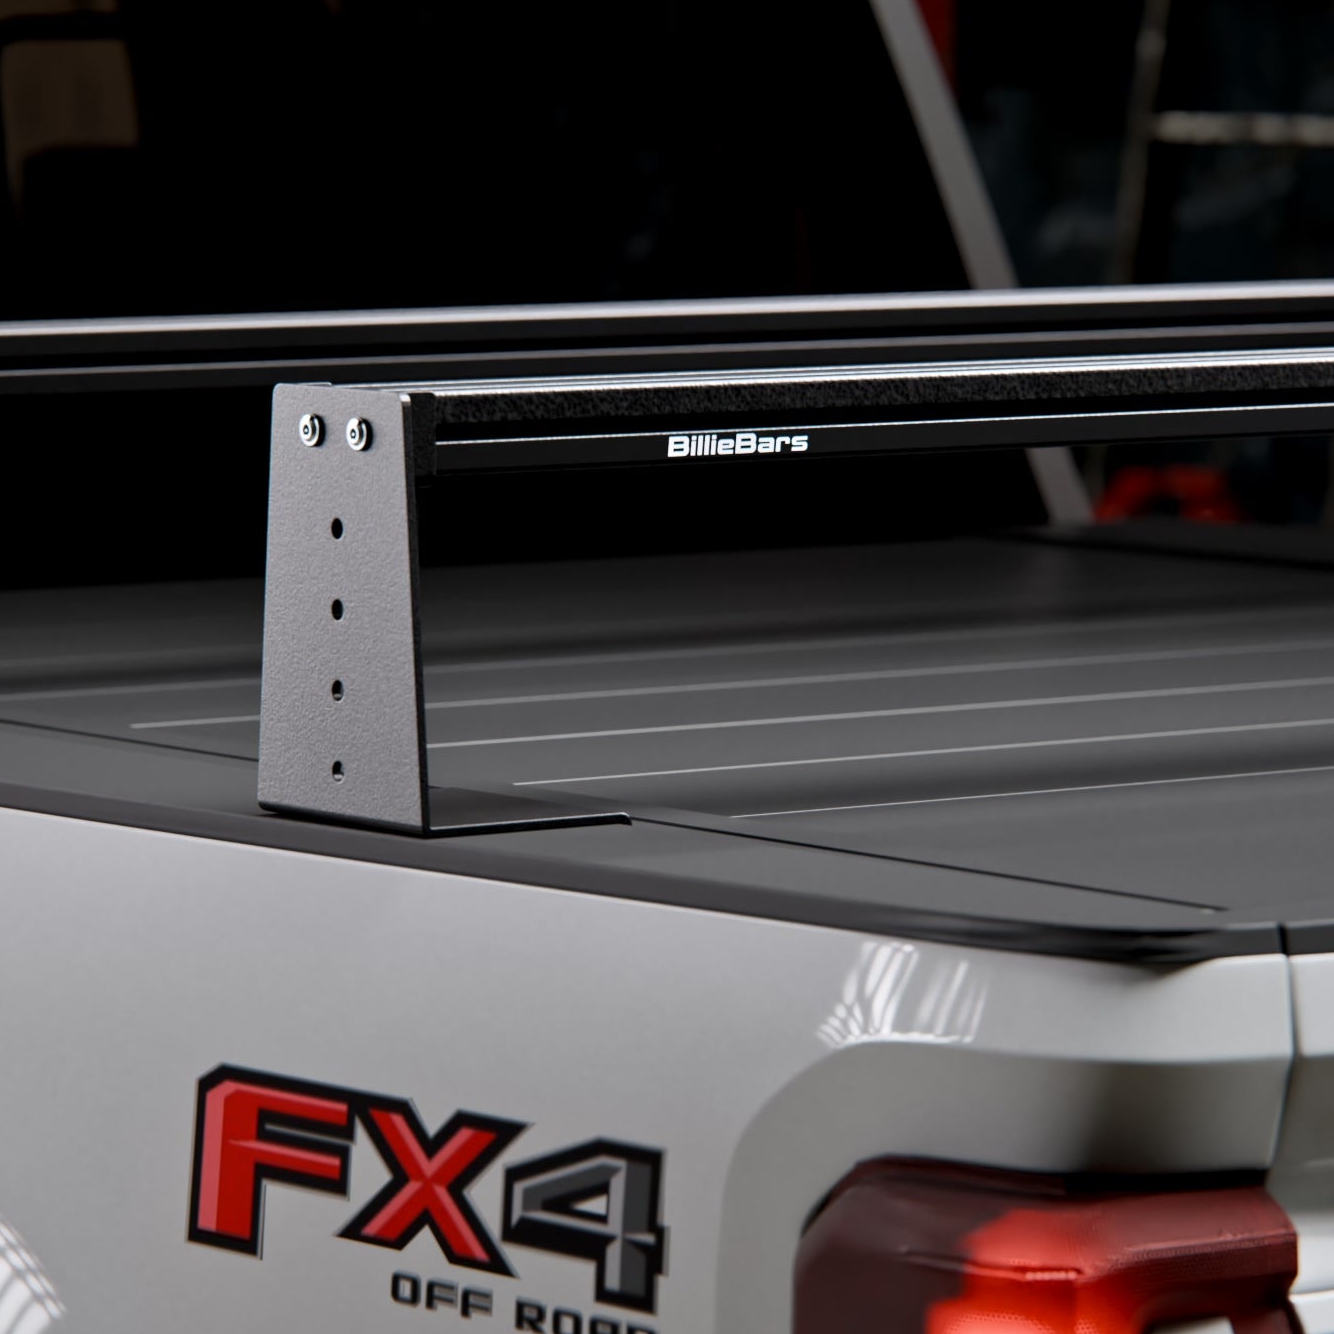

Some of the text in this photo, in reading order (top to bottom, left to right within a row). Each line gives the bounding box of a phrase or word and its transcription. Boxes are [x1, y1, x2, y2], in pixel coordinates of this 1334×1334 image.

[667, 432, 809, 458] BillieBars
[186, 1062, 670, 1316] FX4
[390, 1269, 494, 1319] OFF
